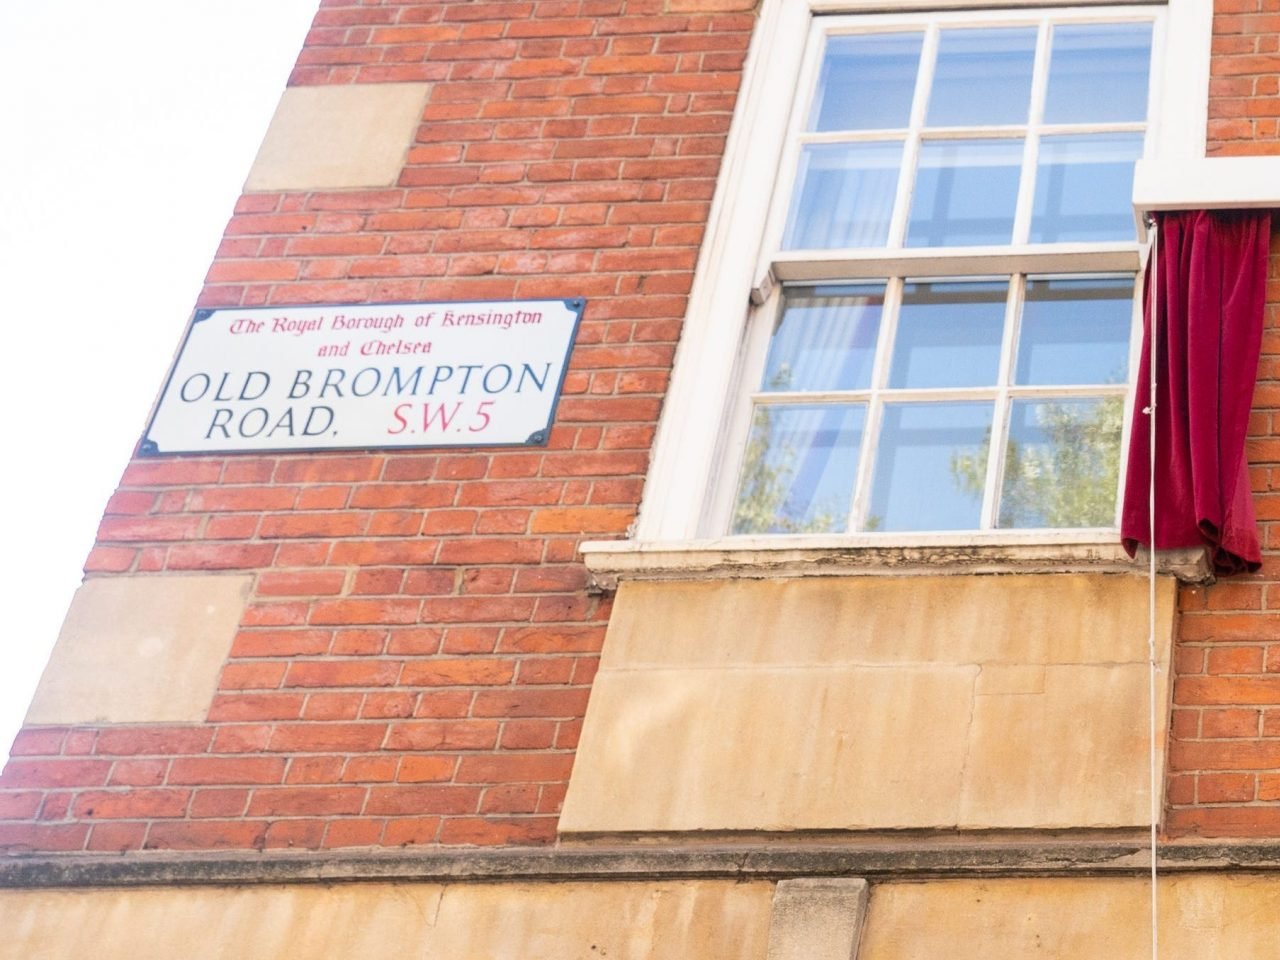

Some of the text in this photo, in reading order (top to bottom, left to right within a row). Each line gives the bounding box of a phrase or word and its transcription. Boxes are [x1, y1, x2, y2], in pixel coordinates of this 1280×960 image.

[229, 309, 543, 335] The Royal Borough of Kensington
[317, 339, 433, 358] and Chelsea
[180, 362, 553, 403] OLD BROMPTON
